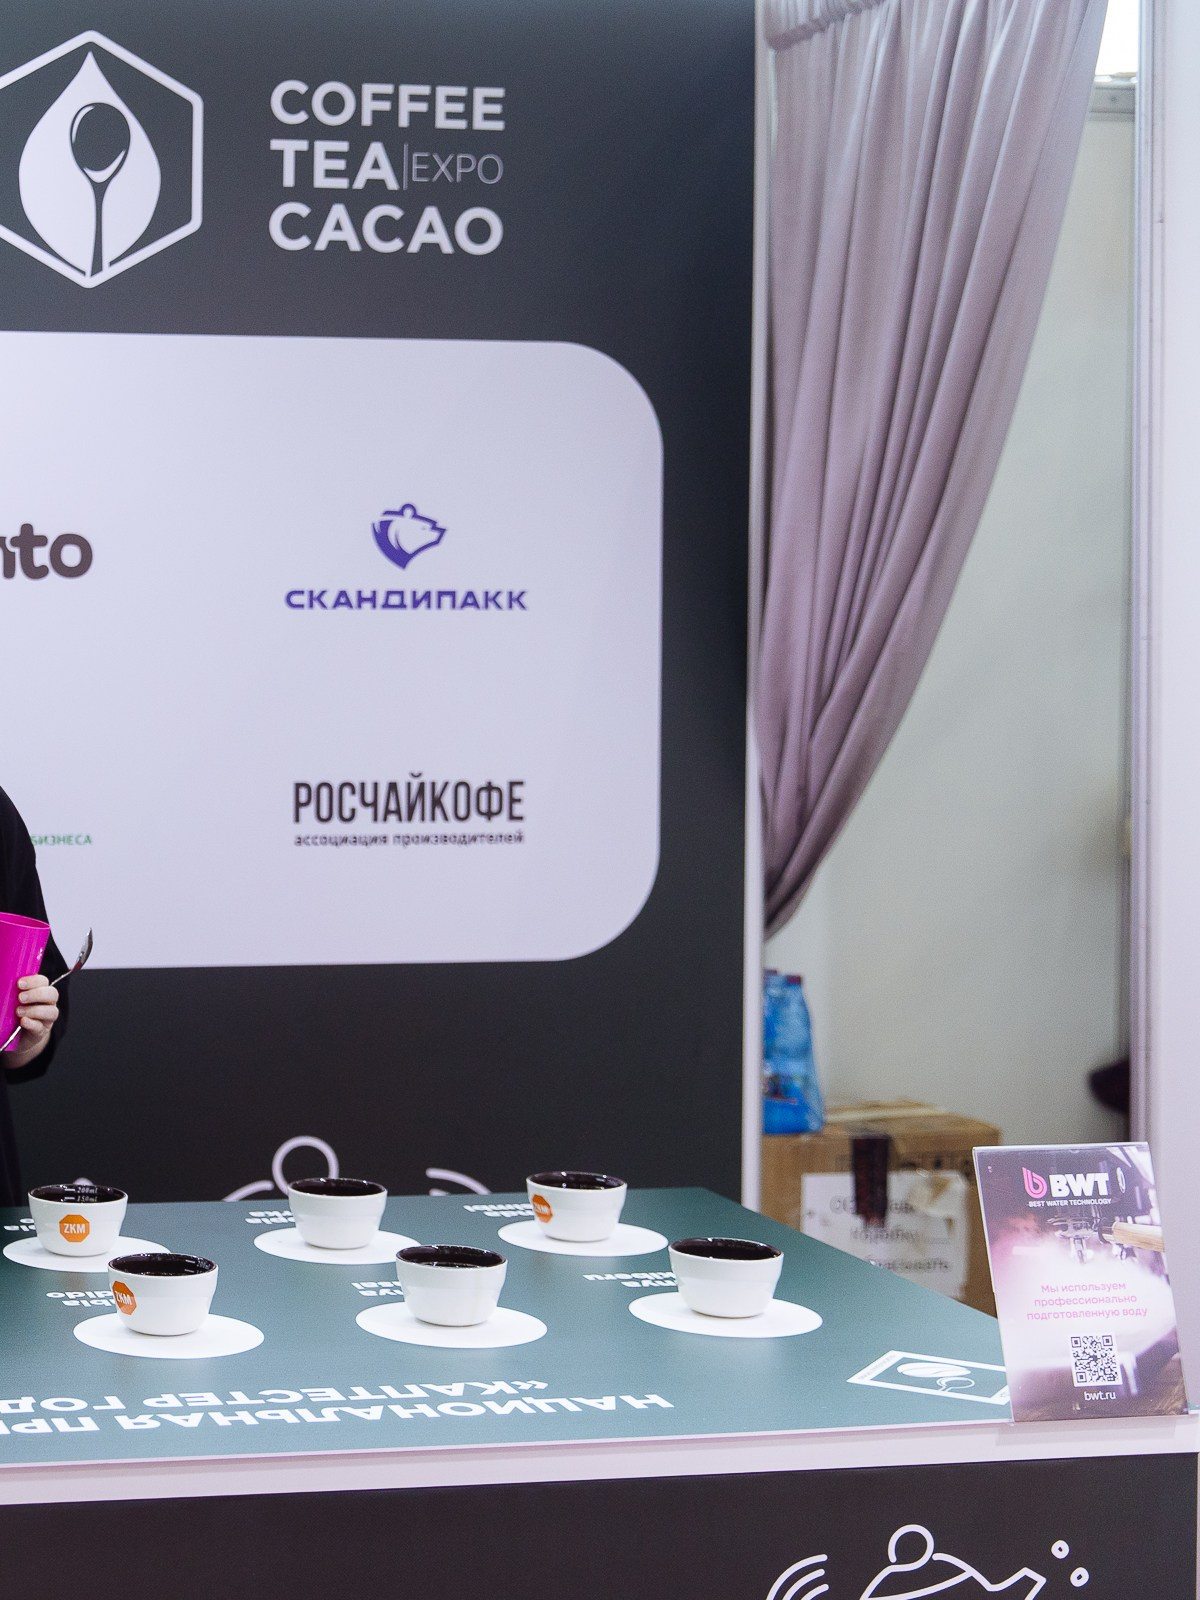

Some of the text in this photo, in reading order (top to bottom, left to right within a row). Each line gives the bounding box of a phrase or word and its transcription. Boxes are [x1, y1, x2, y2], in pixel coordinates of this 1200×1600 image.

[270, 79, 505, 131] COFFEE
[270, 138, 504, 191] TEA EXPO
[268, 201, 504, 255] CACAO
[285, 590, 527, 611] СКАНДИПАКК
[294, 772, 525, 823] РОСЧАЙКОФЕ
[294, 829, 525, 848] ассоциация производителей
[1049, 1172, 1109, 1197] BWT
[1069, 1198, 1112, 1206] TECHNOLOGY
[63, 1223, 86, 1234] ZKM
[620, 1279, 678, 1288] nya
[1041, 1281, 1126, 1293] Мы используем
[114, 1290, 133, 1305] ZKM
[358, 1288, 404, 1297] nya
[1034, 1295, 1137, 1308] профессионально
[1027, 1307, 1148, 1321] подготовленную воду
[143, 1380, 549, 1409] «КАПТЕСТЕР
[1084, 1390, 1116, 1401] bwt.ru
[115, 1393, 674, 1431] НАЦИОНАЛЬНАЯ
